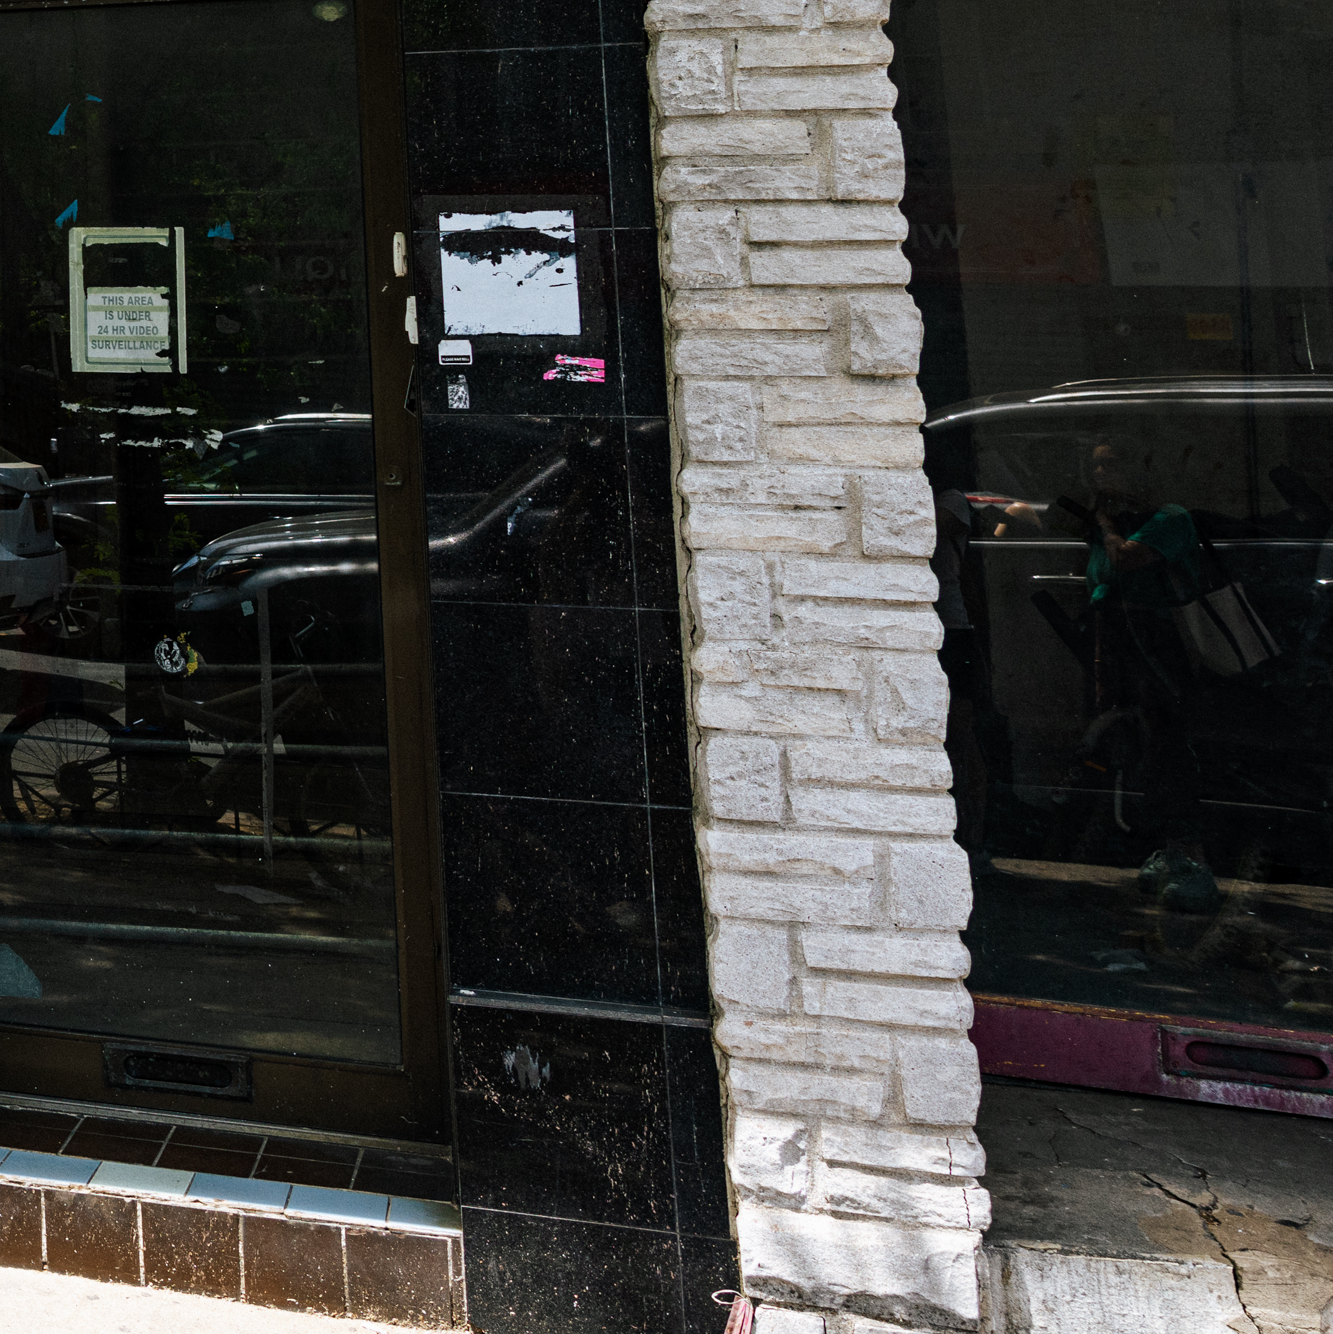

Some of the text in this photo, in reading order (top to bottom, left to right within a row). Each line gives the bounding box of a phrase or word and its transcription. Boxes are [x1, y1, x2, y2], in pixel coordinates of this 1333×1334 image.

[102, 295, 154, 306] THIS AREA
[104, 311, 151, 321] IS UNDER
[97, 325, 159, 336] 24 HR VIDEO
[91, 340, 166, 351] SURVEILLANCE
